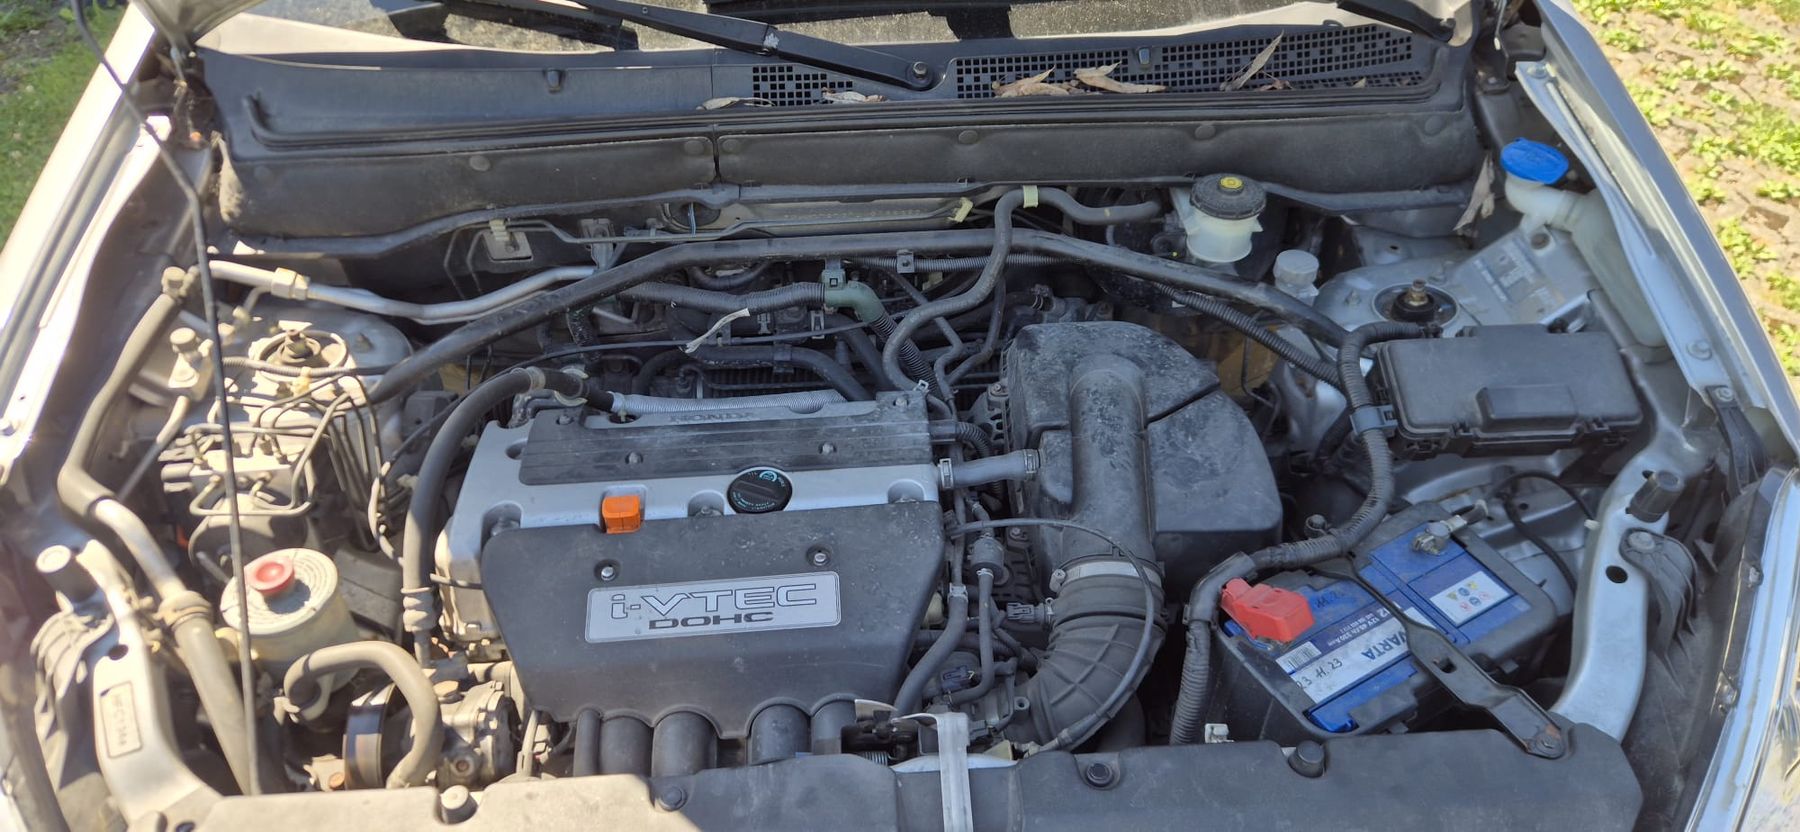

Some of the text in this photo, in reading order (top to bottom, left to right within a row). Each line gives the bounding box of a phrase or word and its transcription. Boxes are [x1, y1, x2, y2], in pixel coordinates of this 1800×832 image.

[611, 583, 817, 619] i-VTEC
[648, 611, 774, 630] DOHC
[1330, 658, 1343, 670] 23
